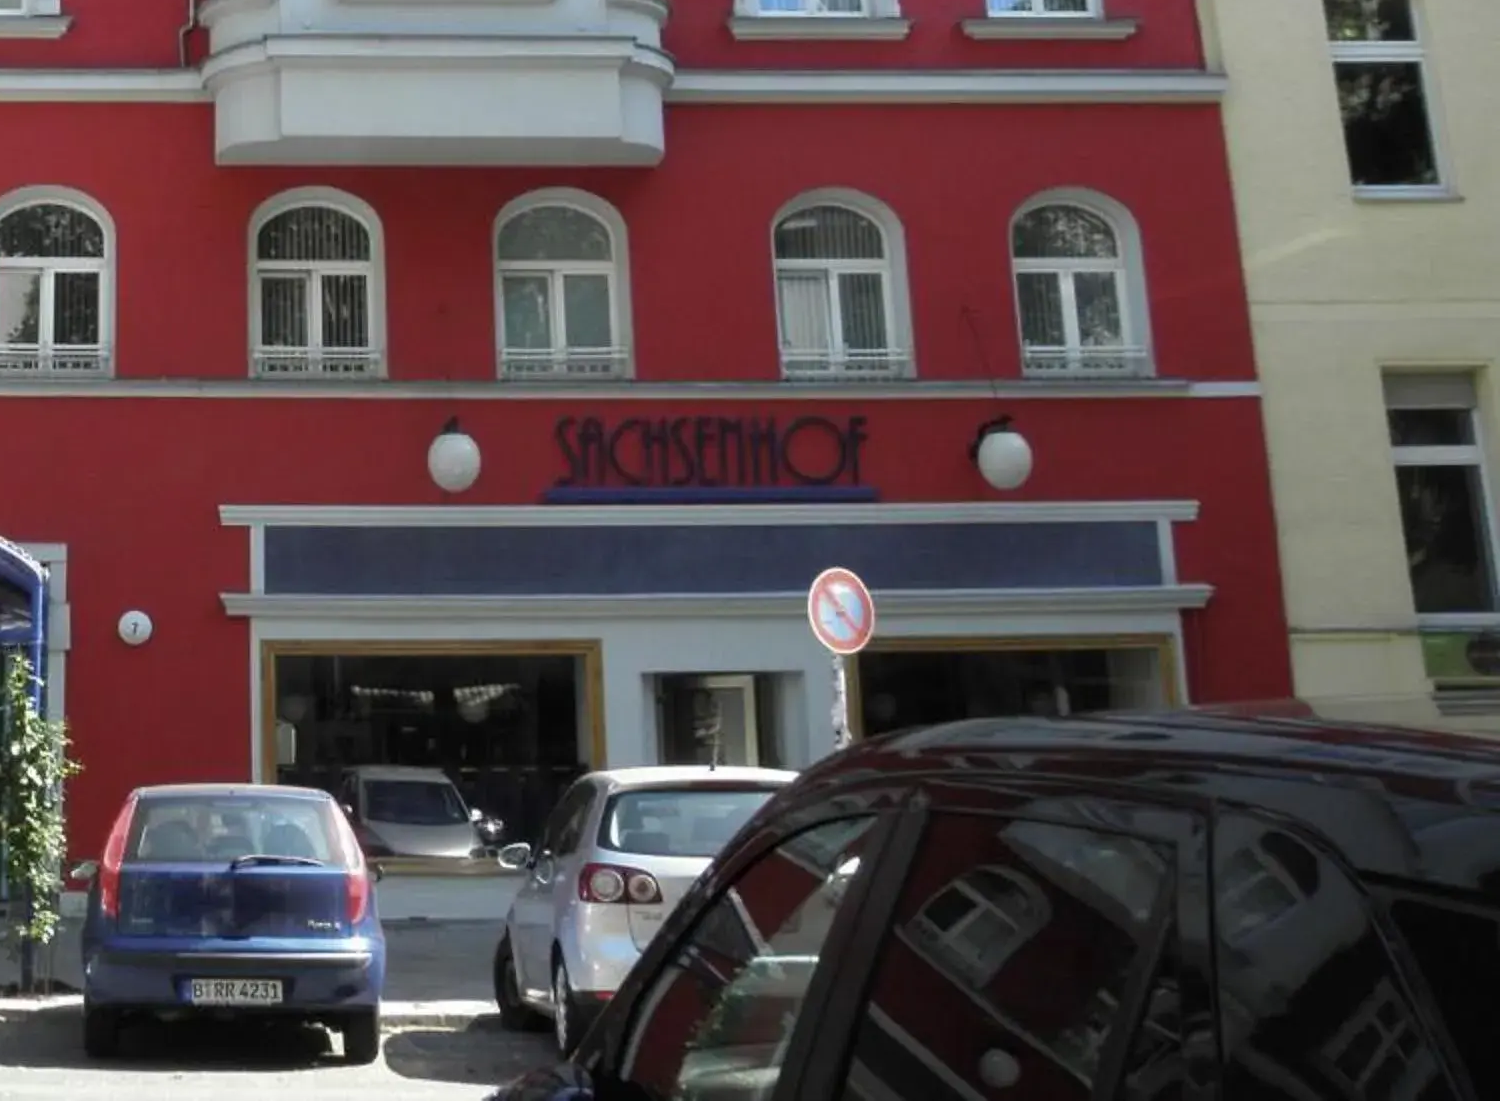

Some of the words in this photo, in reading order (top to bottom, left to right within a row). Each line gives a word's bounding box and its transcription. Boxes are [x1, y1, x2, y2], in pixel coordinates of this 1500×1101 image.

[553, 415, 869, 487] SACHSENHOF
[194, 982, 203, 997] B
[240, 982, 280, 999] 4231
